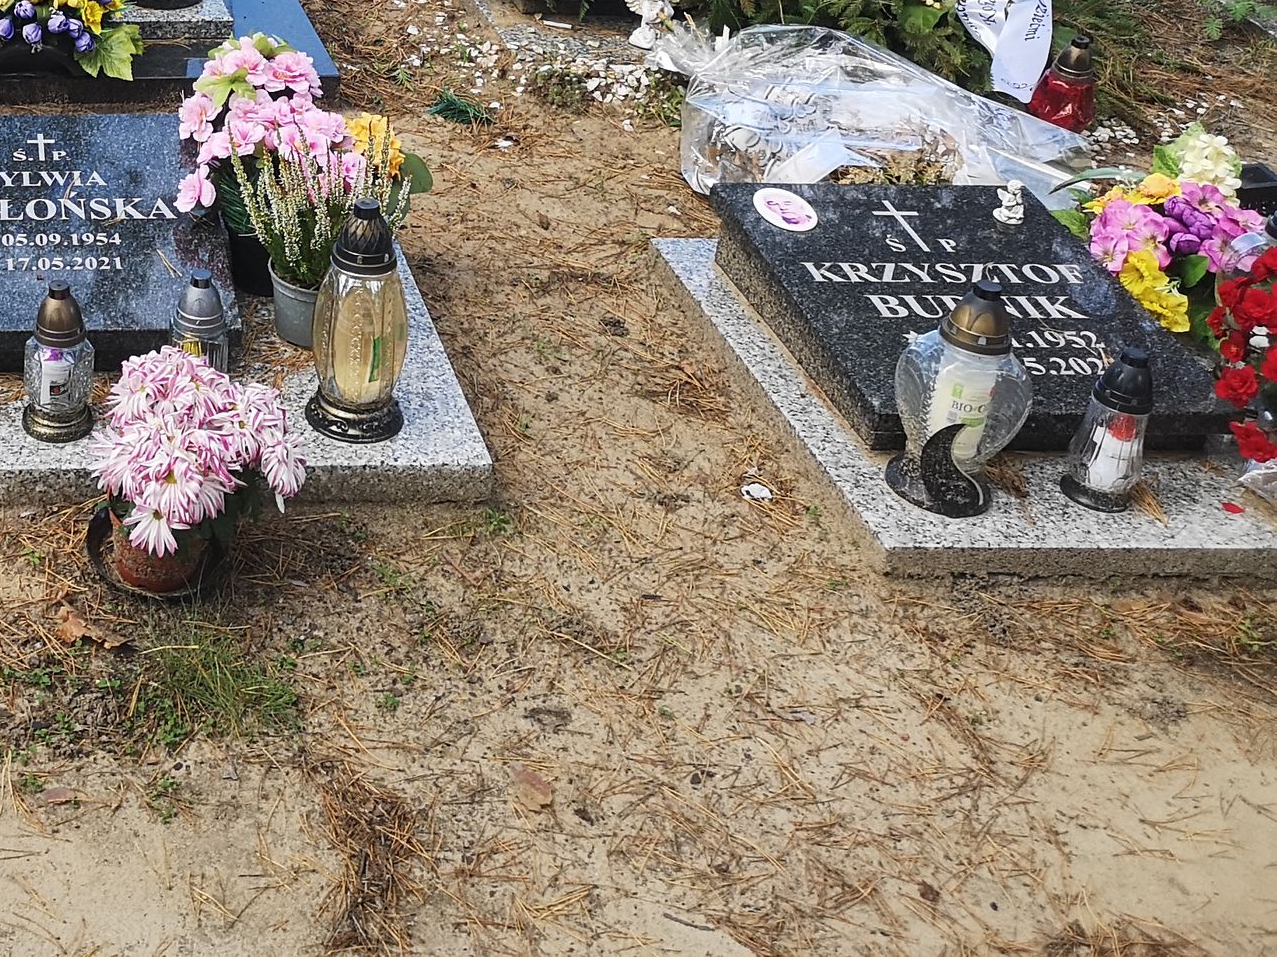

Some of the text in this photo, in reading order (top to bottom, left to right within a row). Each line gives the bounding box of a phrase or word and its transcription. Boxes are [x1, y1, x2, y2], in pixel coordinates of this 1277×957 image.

[1, 232, 122, 247] 05.09.1954
[935, 238, 957, 253] P
[6, 256, 124, 271] 17.05.2021
[799, 261, 1085, 284] KRZYSZTOF
